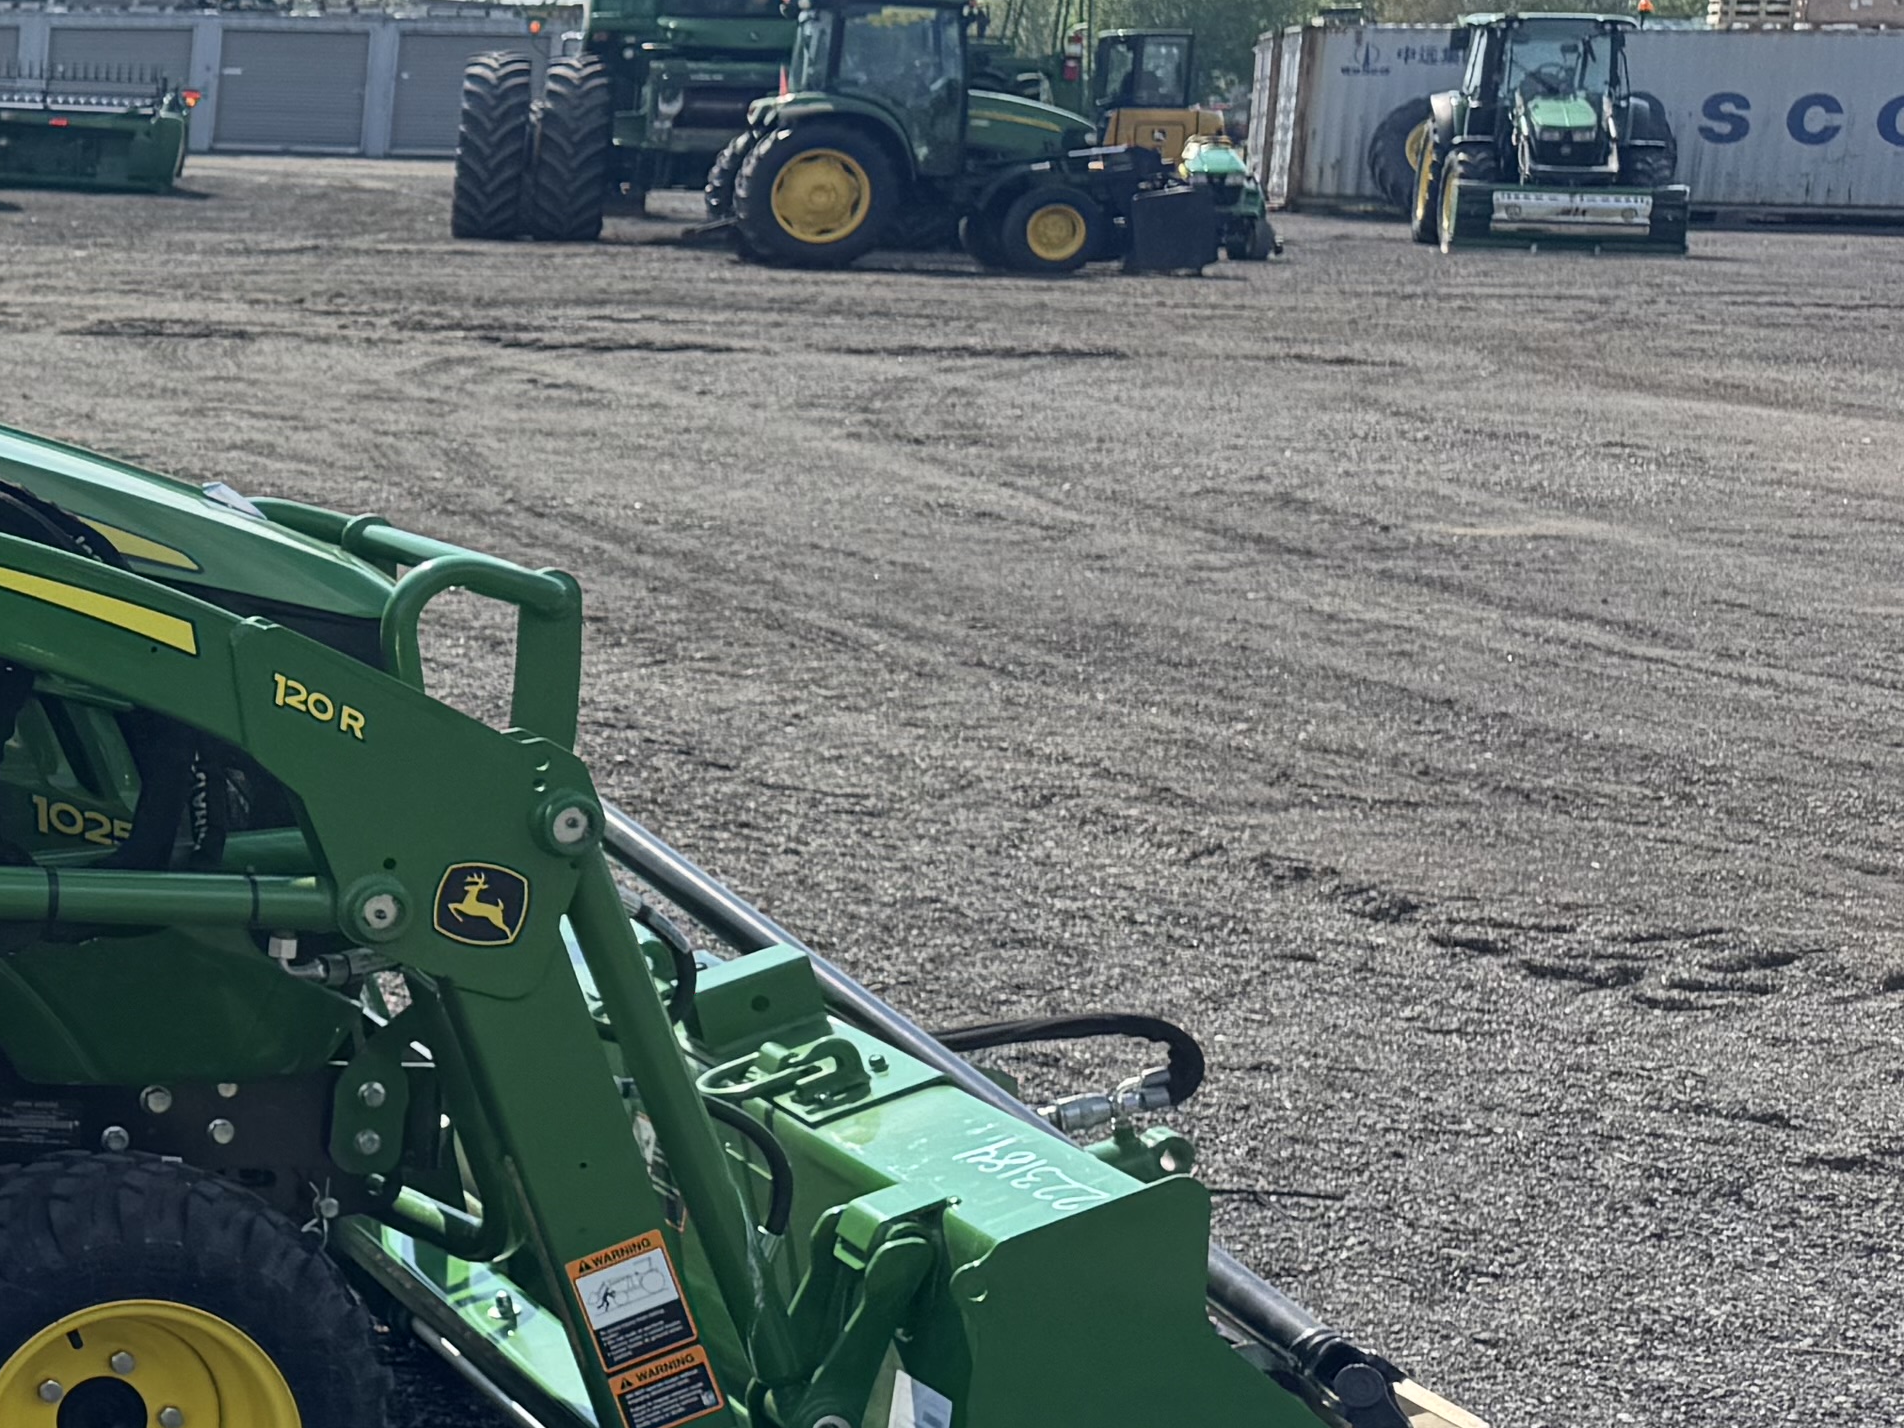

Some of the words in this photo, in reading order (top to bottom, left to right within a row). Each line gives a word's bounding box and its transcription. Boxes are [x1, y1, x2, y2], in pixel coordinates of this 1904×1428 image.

[273, 671, 334, 722] 120
[339, 704, 366, 741] R
[591, 1237, 652, 1269] WARNING
[634, 1352, 696, 1383] WARNING
